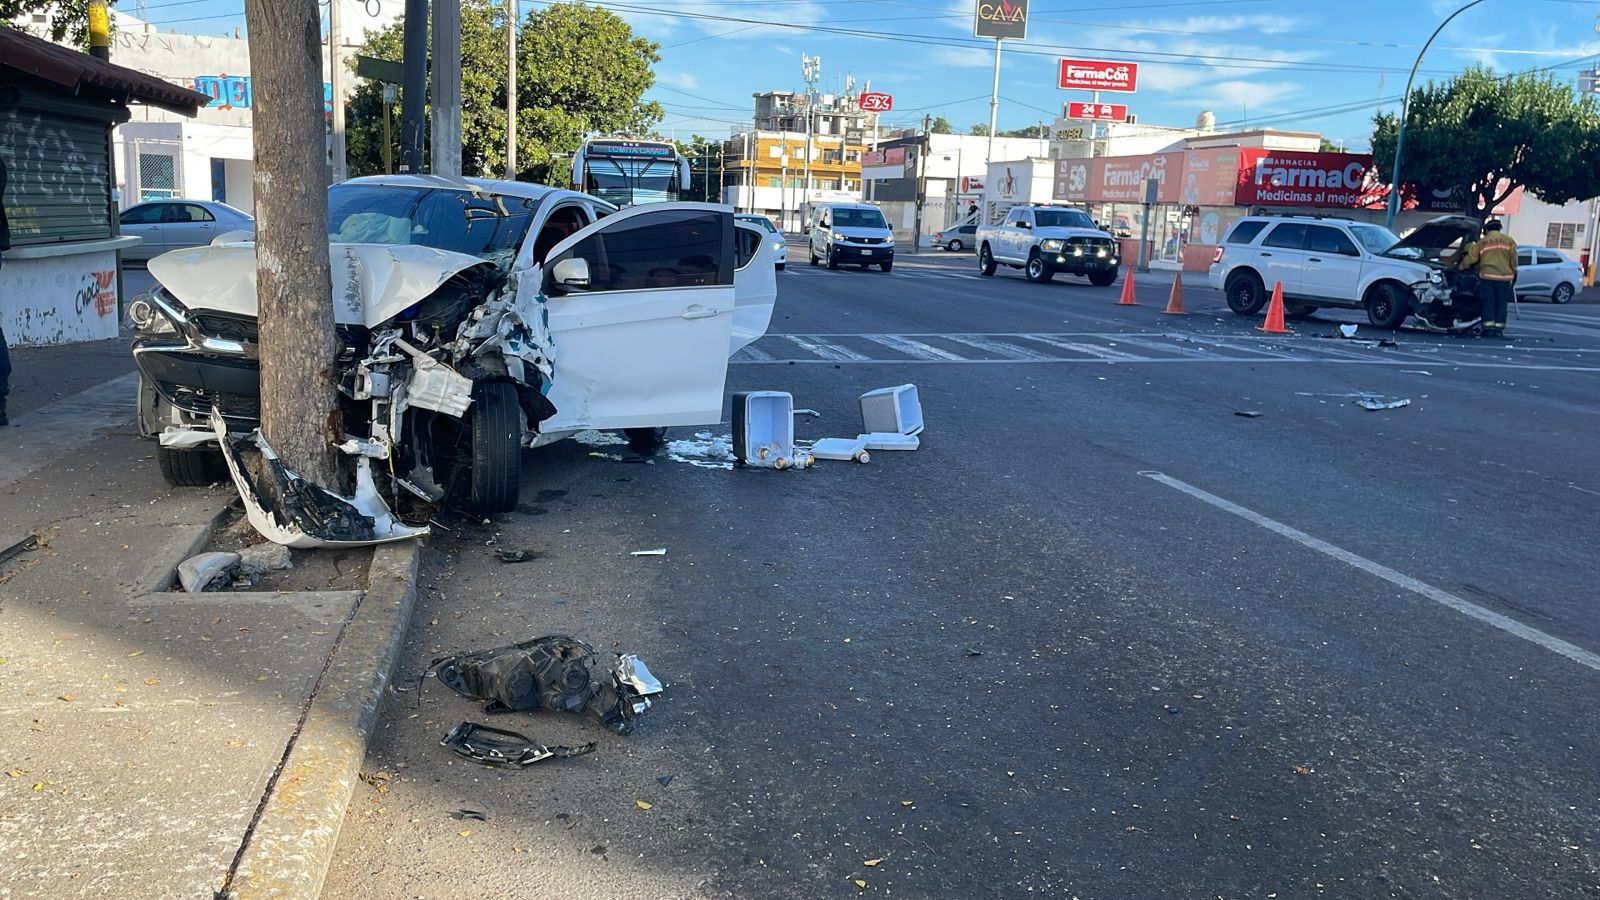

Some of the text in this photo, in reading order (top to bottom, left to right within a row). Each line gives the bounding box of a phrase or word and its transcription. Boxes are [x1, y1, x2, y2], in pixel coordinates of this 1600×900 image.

[980, 3, 1025, 22] CAVA
[1082, 104, 1095, 113] 24
[1255, 157, 1362, 189] FarmaC
[1256, 190, 1313, 202] Medicinas
[1316, 191, 1325, 201] al
